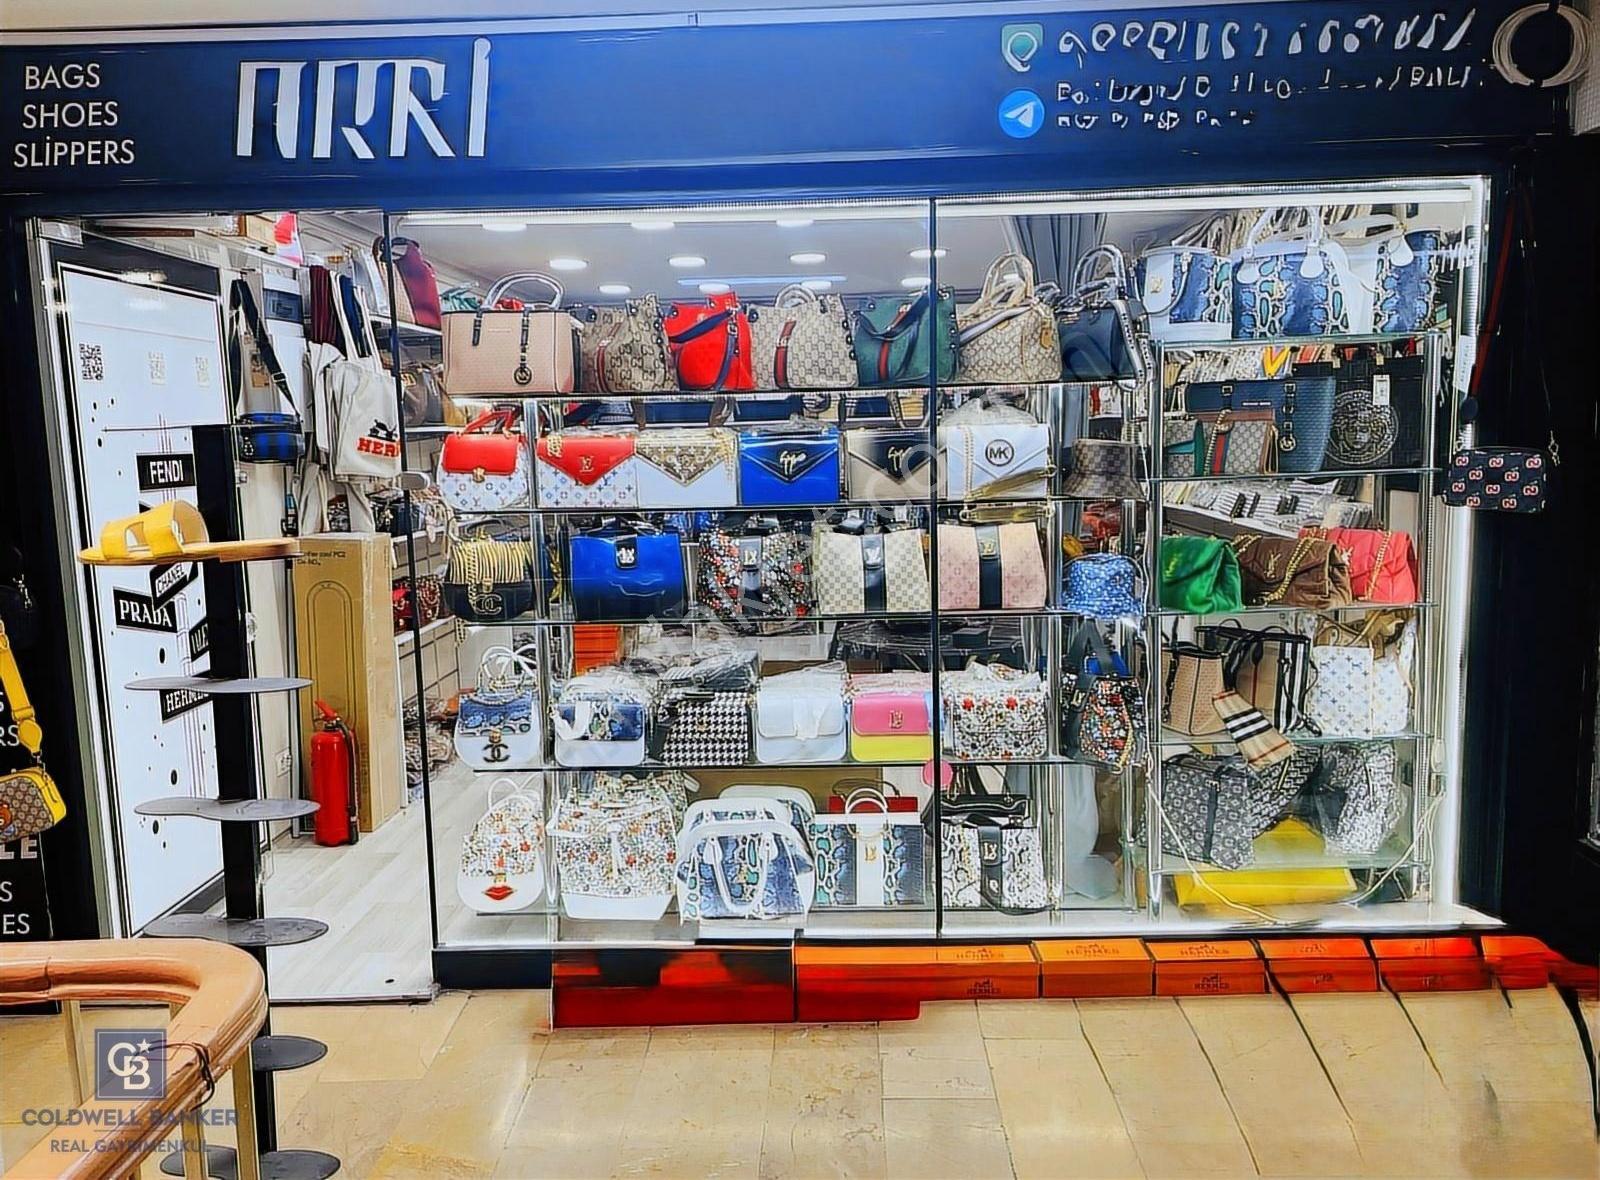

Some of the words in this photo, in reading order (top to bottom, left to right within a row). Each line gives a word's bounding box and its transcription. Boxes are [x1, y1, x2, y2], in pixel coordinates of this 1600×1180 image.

[25, 63, 101, 90] BAGS
[22, 101, 119, 129] SHOES
[149, 459, 184, 484] FENDI
[157, 563, 184, 594] CHANEL
[119, 599, 172, 628] PRADA
